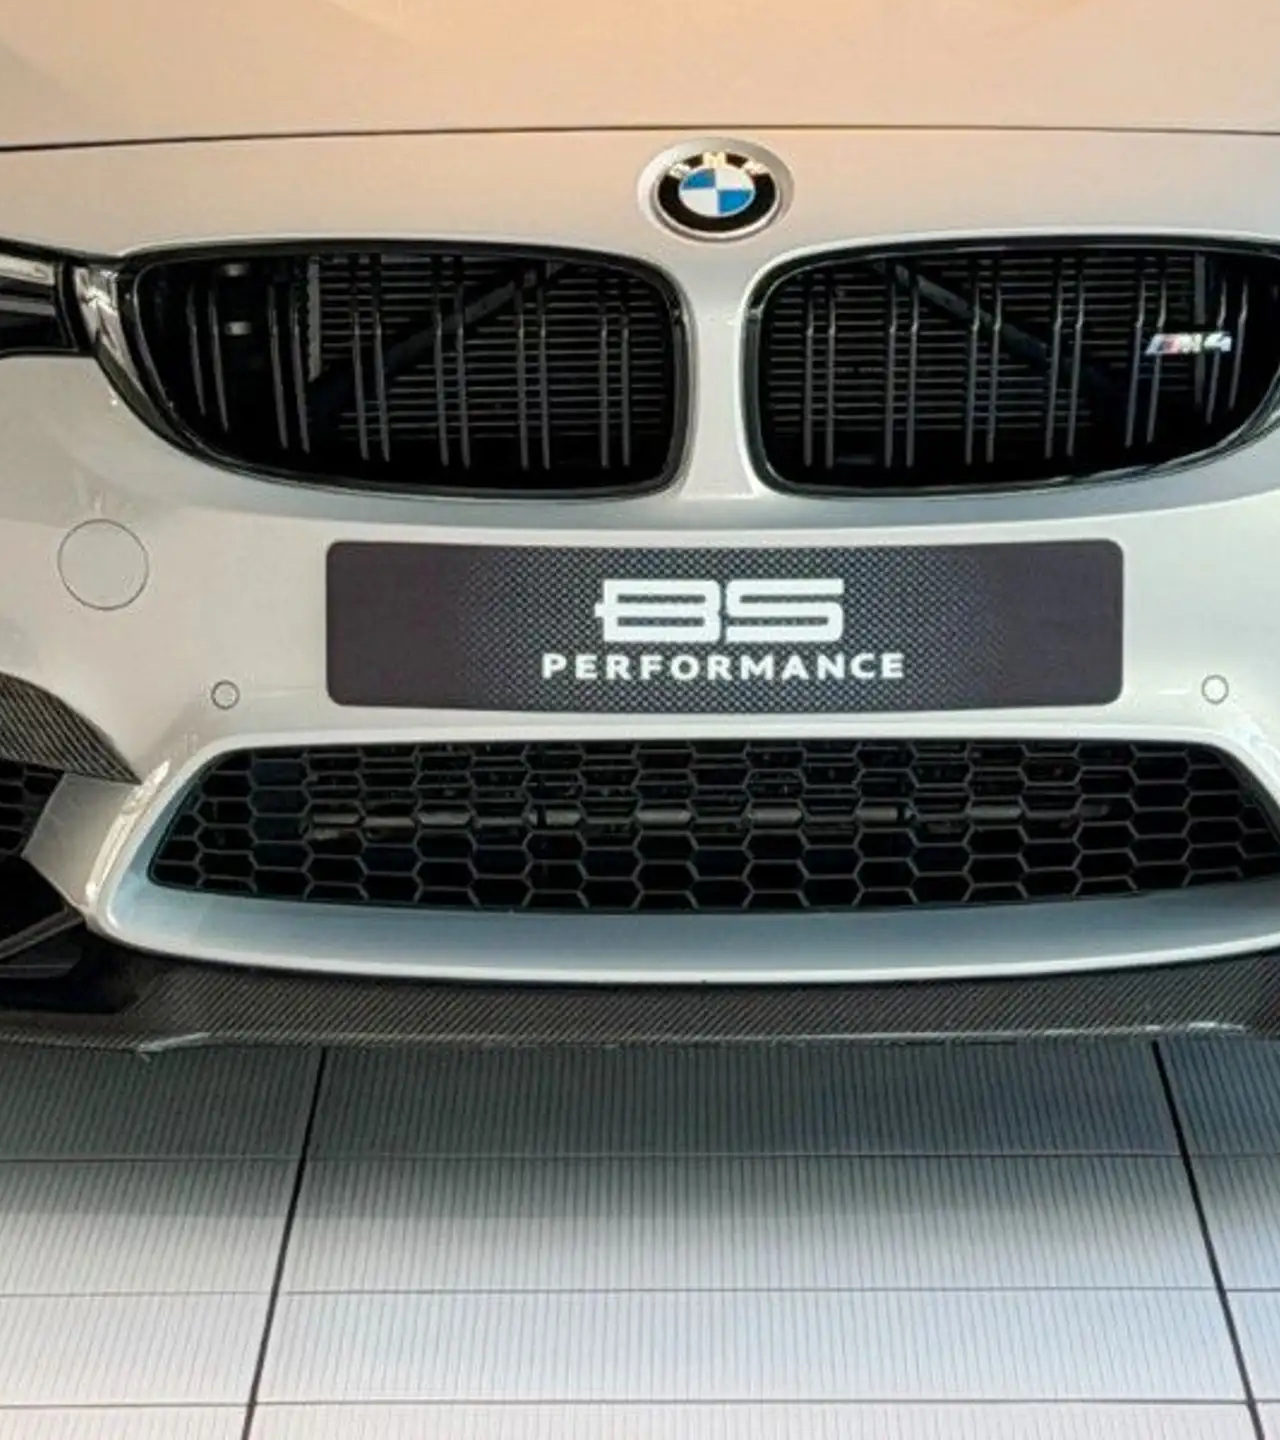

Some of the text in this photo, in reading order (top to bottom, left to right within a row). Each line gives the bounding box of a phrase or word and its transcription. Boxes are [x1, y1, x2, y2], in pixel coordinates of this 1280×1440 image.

[669, 150, 770, 178] BMW
[1156, 332, 1233, 354] M4
[595, 578, 844, 643] BS
[542, 652, 904, 682] PERFORMANCE
